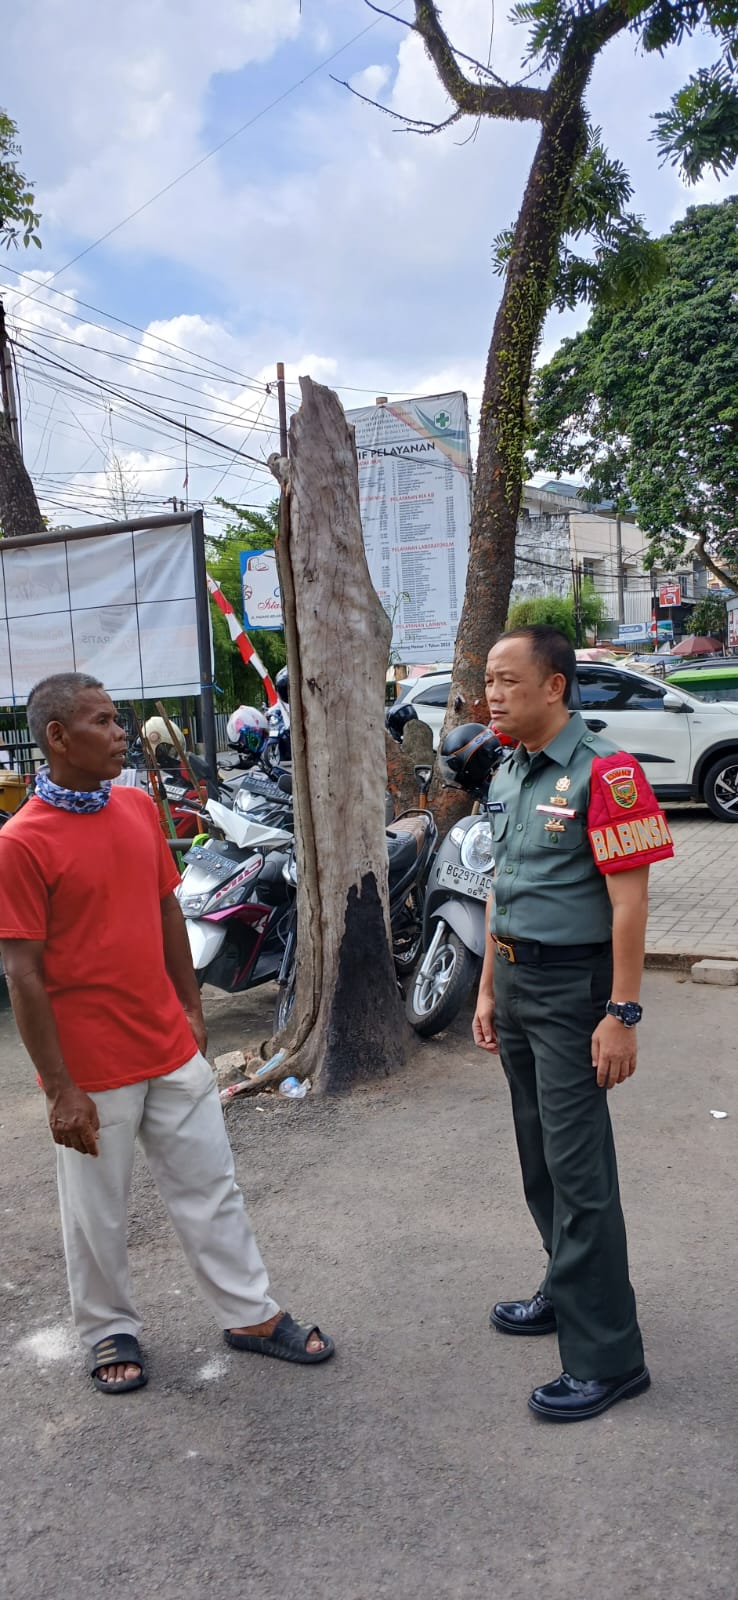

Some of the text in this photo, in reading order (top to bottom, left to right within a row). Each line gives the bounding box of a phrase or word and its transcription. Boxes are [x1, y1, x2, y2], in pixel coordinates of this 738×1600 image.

[358, 442, 436, 460] IF PELAYANAN
[590, 815, 672, 862] BABINSA
